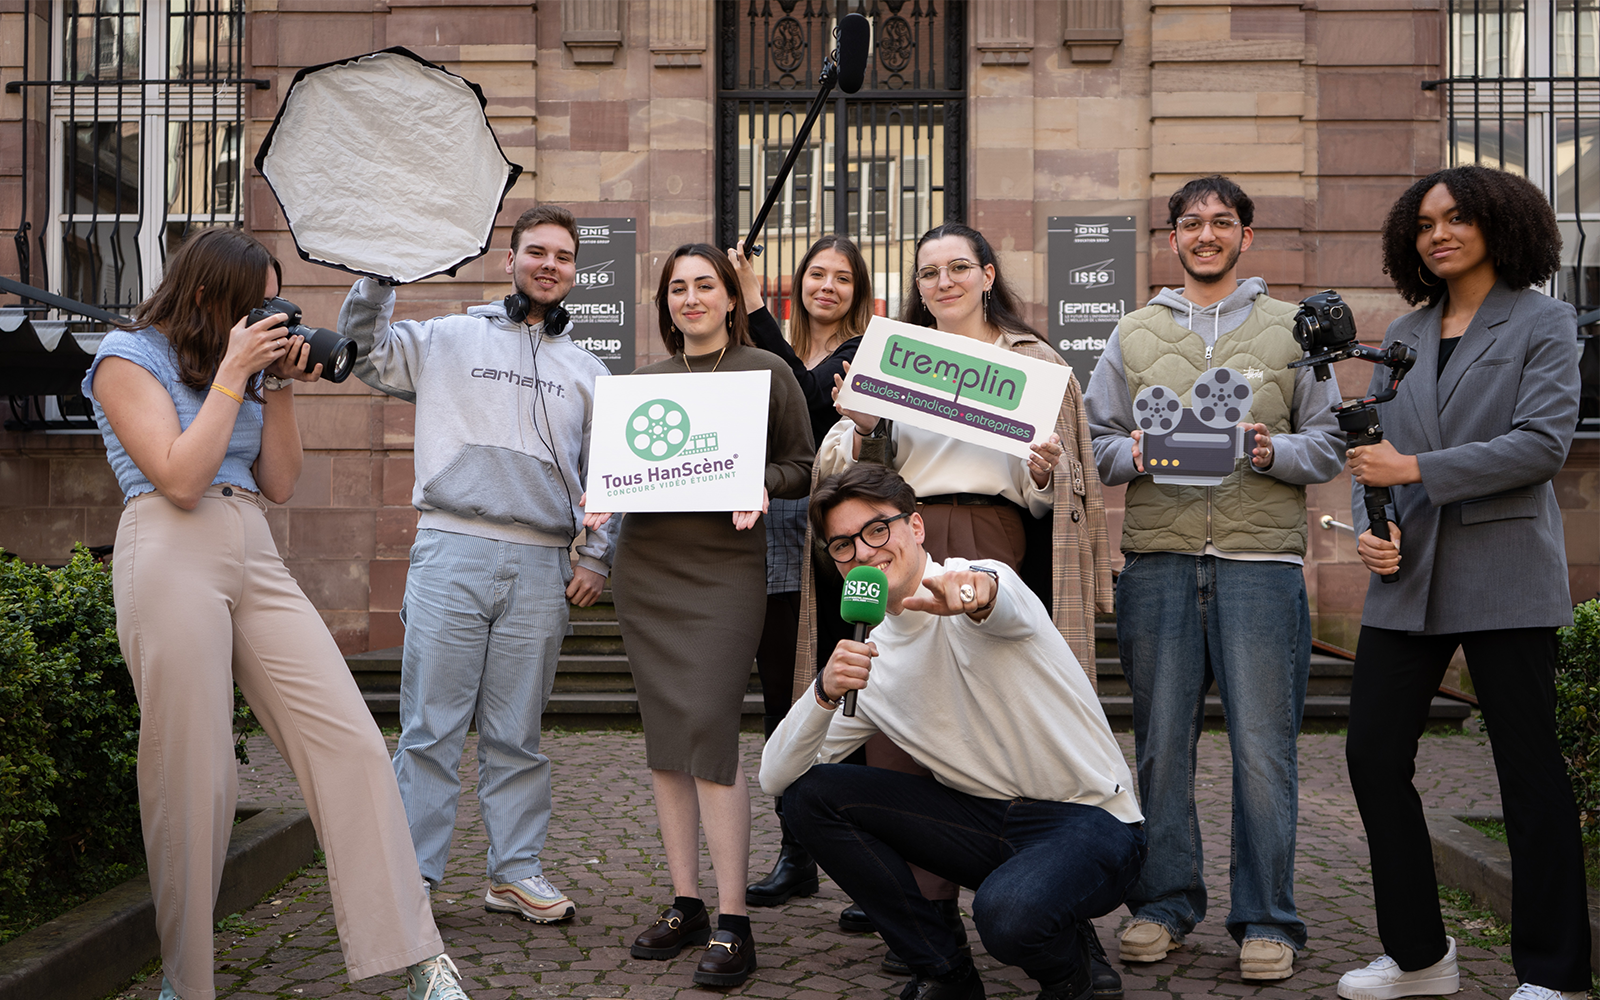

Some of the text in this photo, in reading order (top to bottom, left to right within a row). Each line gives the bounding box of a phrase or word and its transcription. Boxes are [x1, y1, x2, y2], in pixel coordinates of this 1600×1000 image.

[576, 273, 609, 284] ISEG
[1075, 271, 1109, 283] ISEG
[573, 337, 622, 353] artsup
[889, 341, 1016, 403] tremplin
[861, 380, 1031, 439] études handicap entreprises
[602, 474, 643, 489] Tous
[607, 471, 736, 497] CONCOURS VIDÉO ÉTUDIANT
